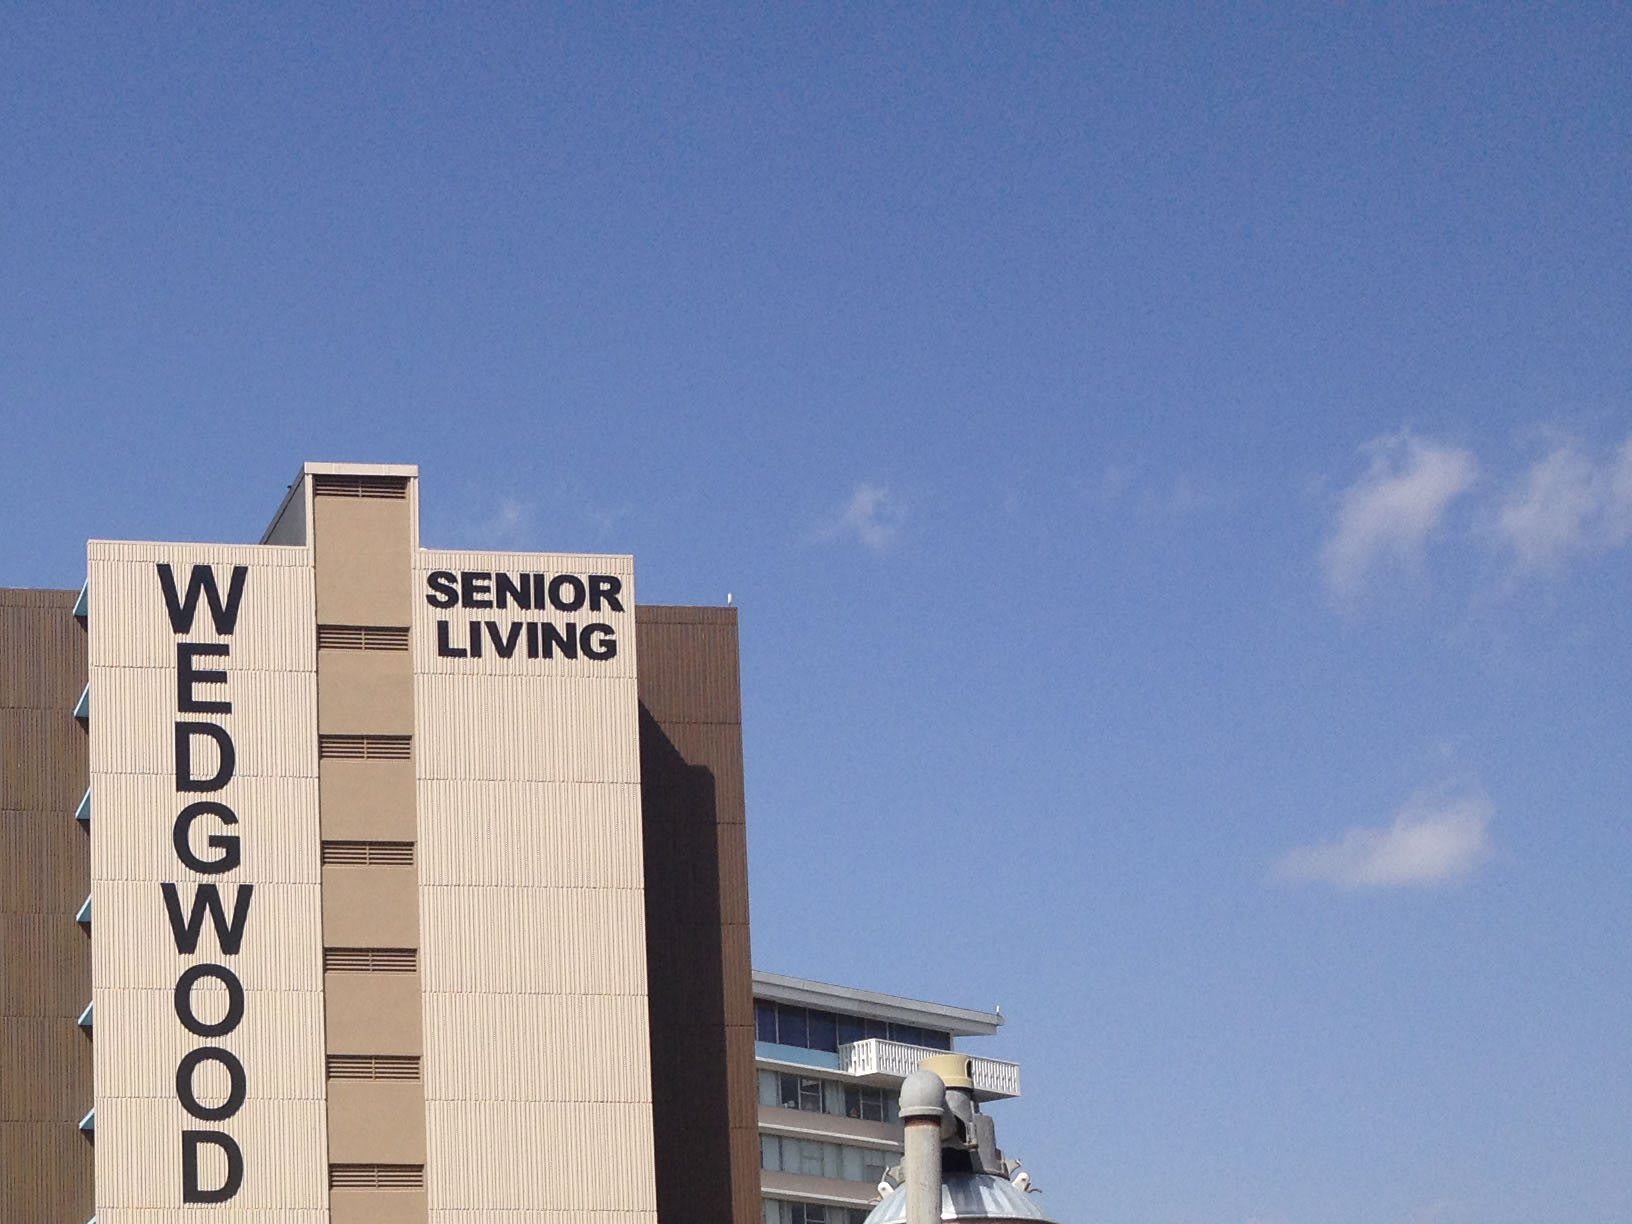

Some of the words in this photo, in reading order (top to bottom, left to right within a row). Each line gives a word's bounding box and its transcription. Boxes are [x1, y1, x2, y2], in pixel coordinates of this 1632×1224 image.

[426, 570, 625, 613] SENIOR
[436, 619, 618, 661] LIVING
[156, 563, 253, 1205] WEDGWOOD
